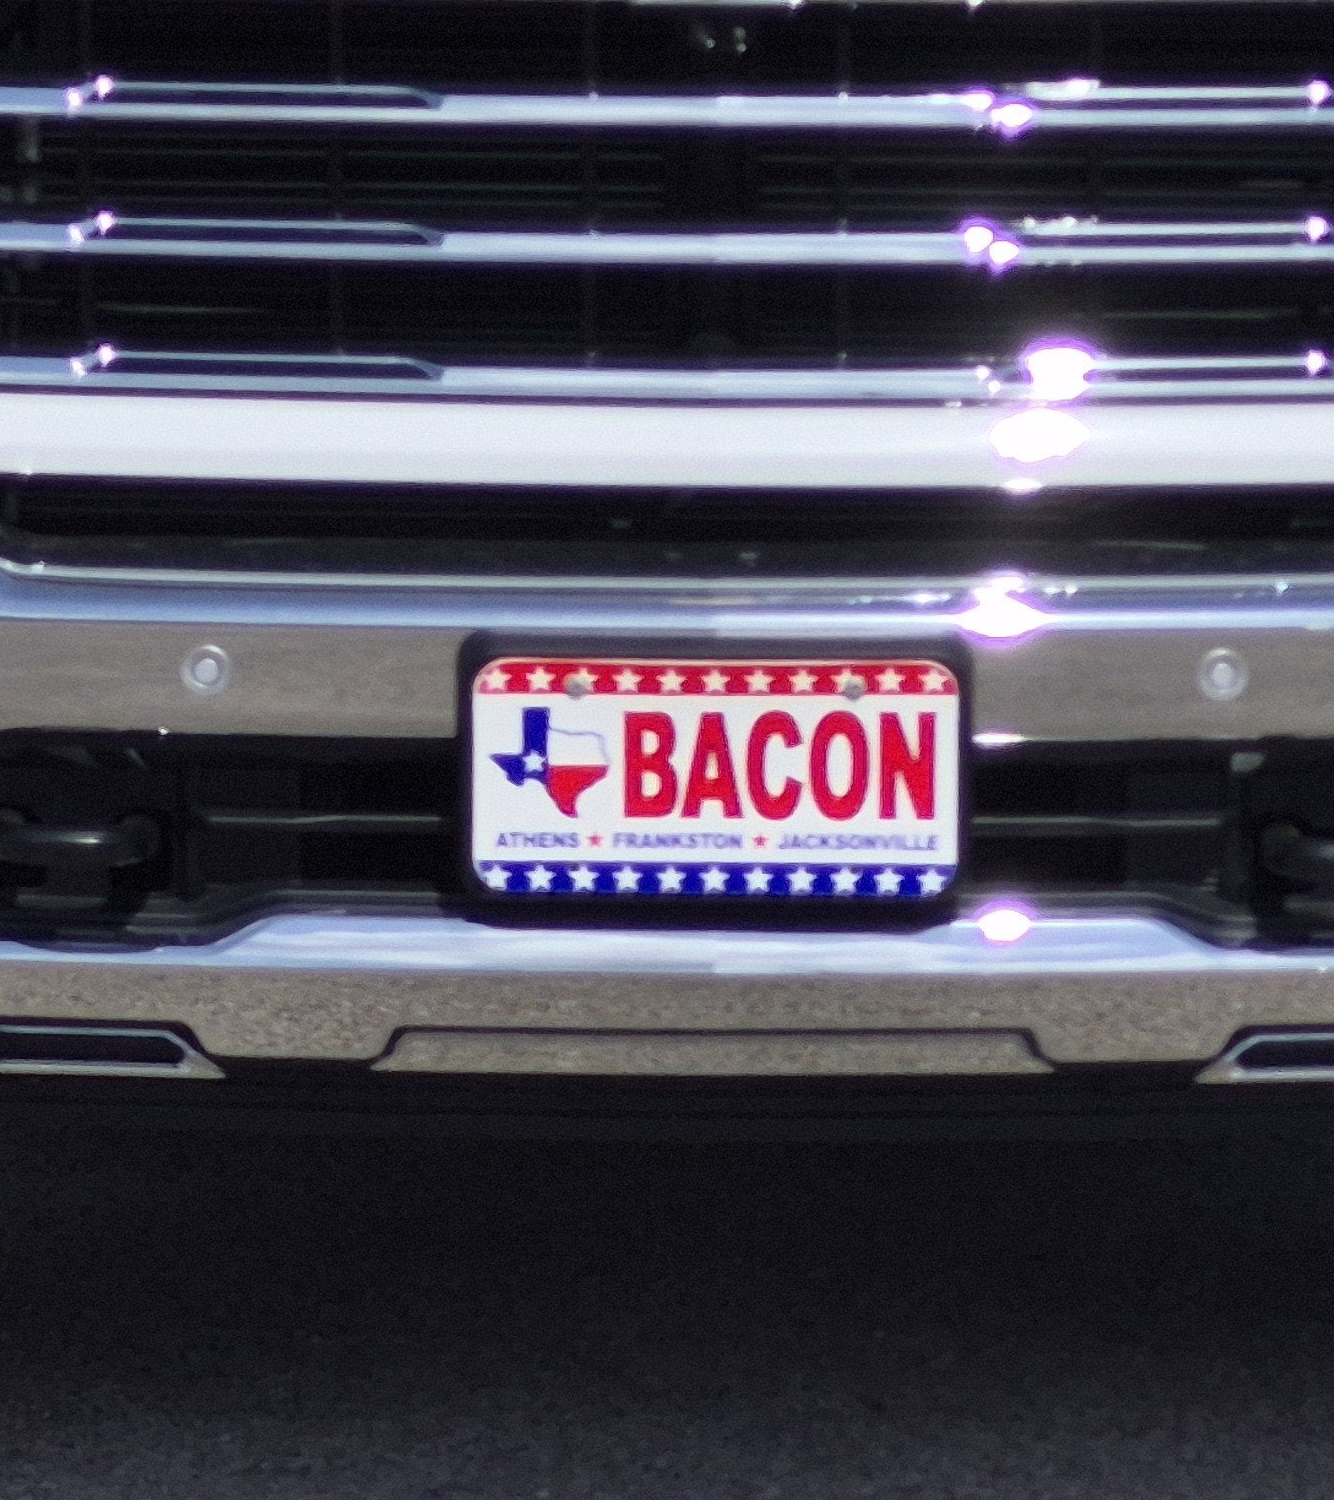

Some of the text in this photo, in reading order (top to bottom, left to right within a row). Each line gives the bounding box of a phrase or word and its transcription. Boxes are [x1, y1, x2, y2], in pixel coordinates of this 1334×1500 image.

[623, 709, 937, 821] BACON
[496, 831, 941, 852] ATHENS FRANKSTON JACKSONVILLE
